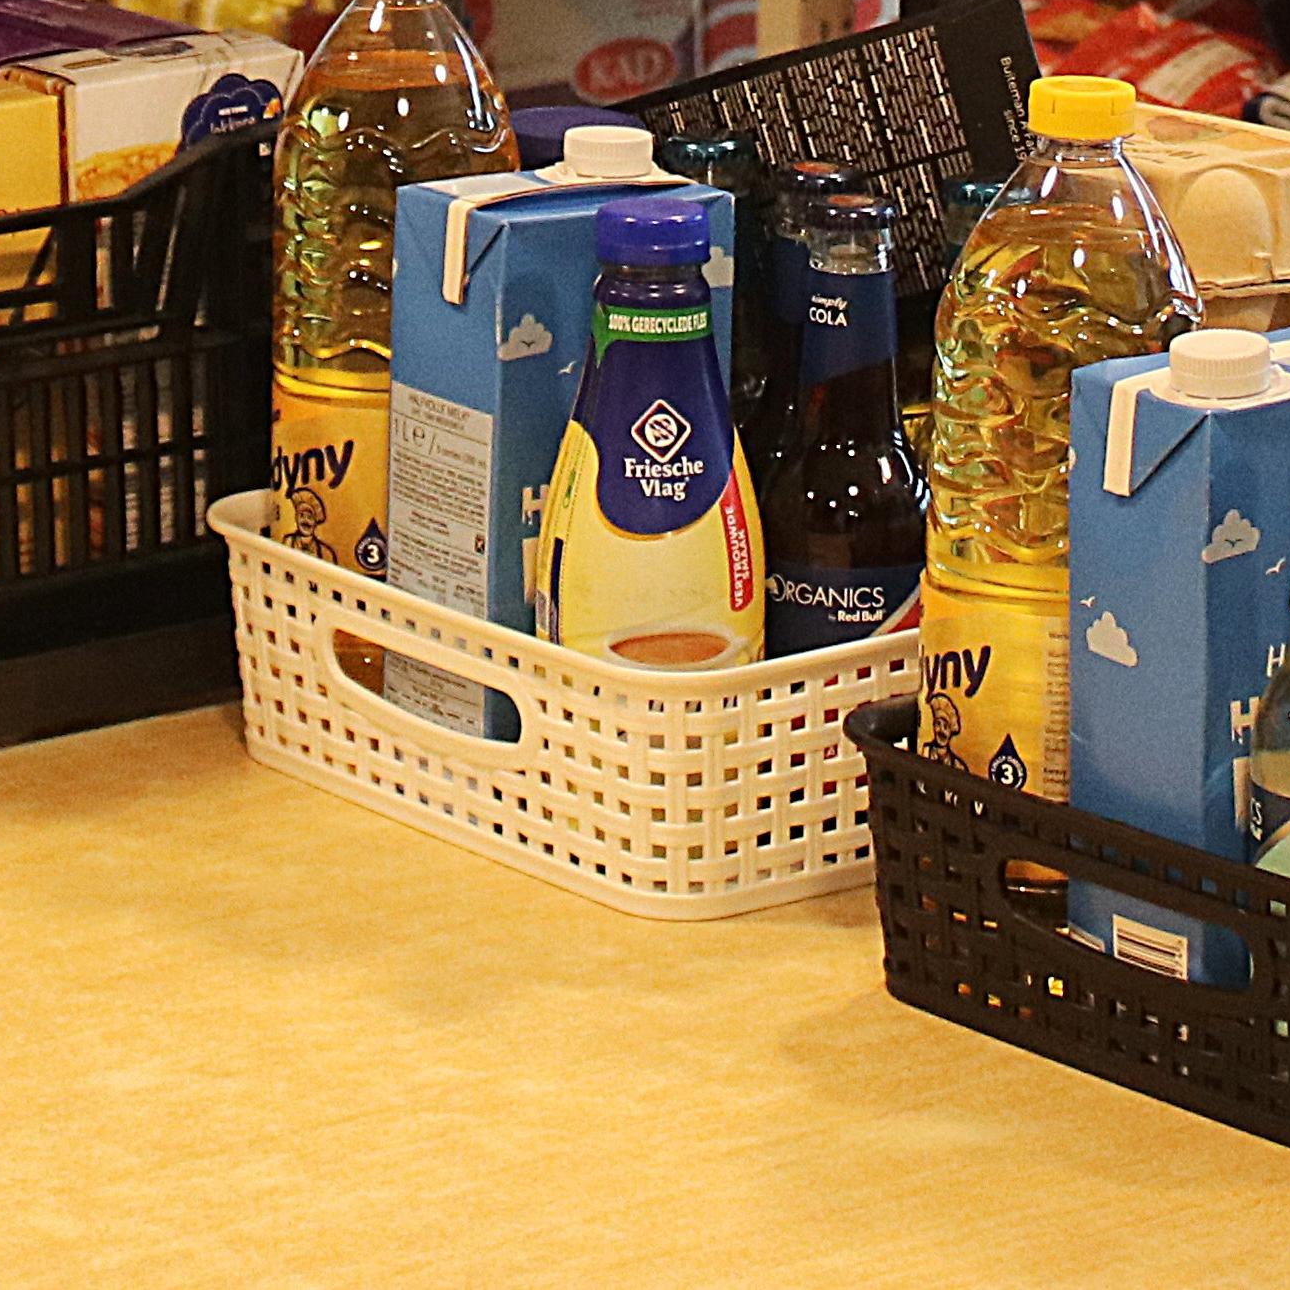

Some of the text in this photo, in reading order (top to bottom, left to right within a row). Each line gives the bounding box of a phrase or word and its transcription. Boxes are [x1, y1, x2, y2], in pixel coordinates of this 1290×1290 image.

[1000, 55, 1026, 124] Buiteman
[608, 313, 630, 332] 100%
[631, 312, 692, 334] GERECYCLEDE
[809, 306, 848, 327] COLA
[623, 456, 704, 480] Friesche
[640, 478, 686, 502] Vlag
[366, 544, 380, 564] 3
[725, 505, 744, 610] VERTROUWDE
[737, 528, 751, 583] SMAAK
[766, 573, 885, 608] ORGANICS
[837, 609, 860, 622] Red
[861, 609, 884, 622] Bull
[921, 644, 991, 704] yny
[1000, 763, 1015, 785] 3
